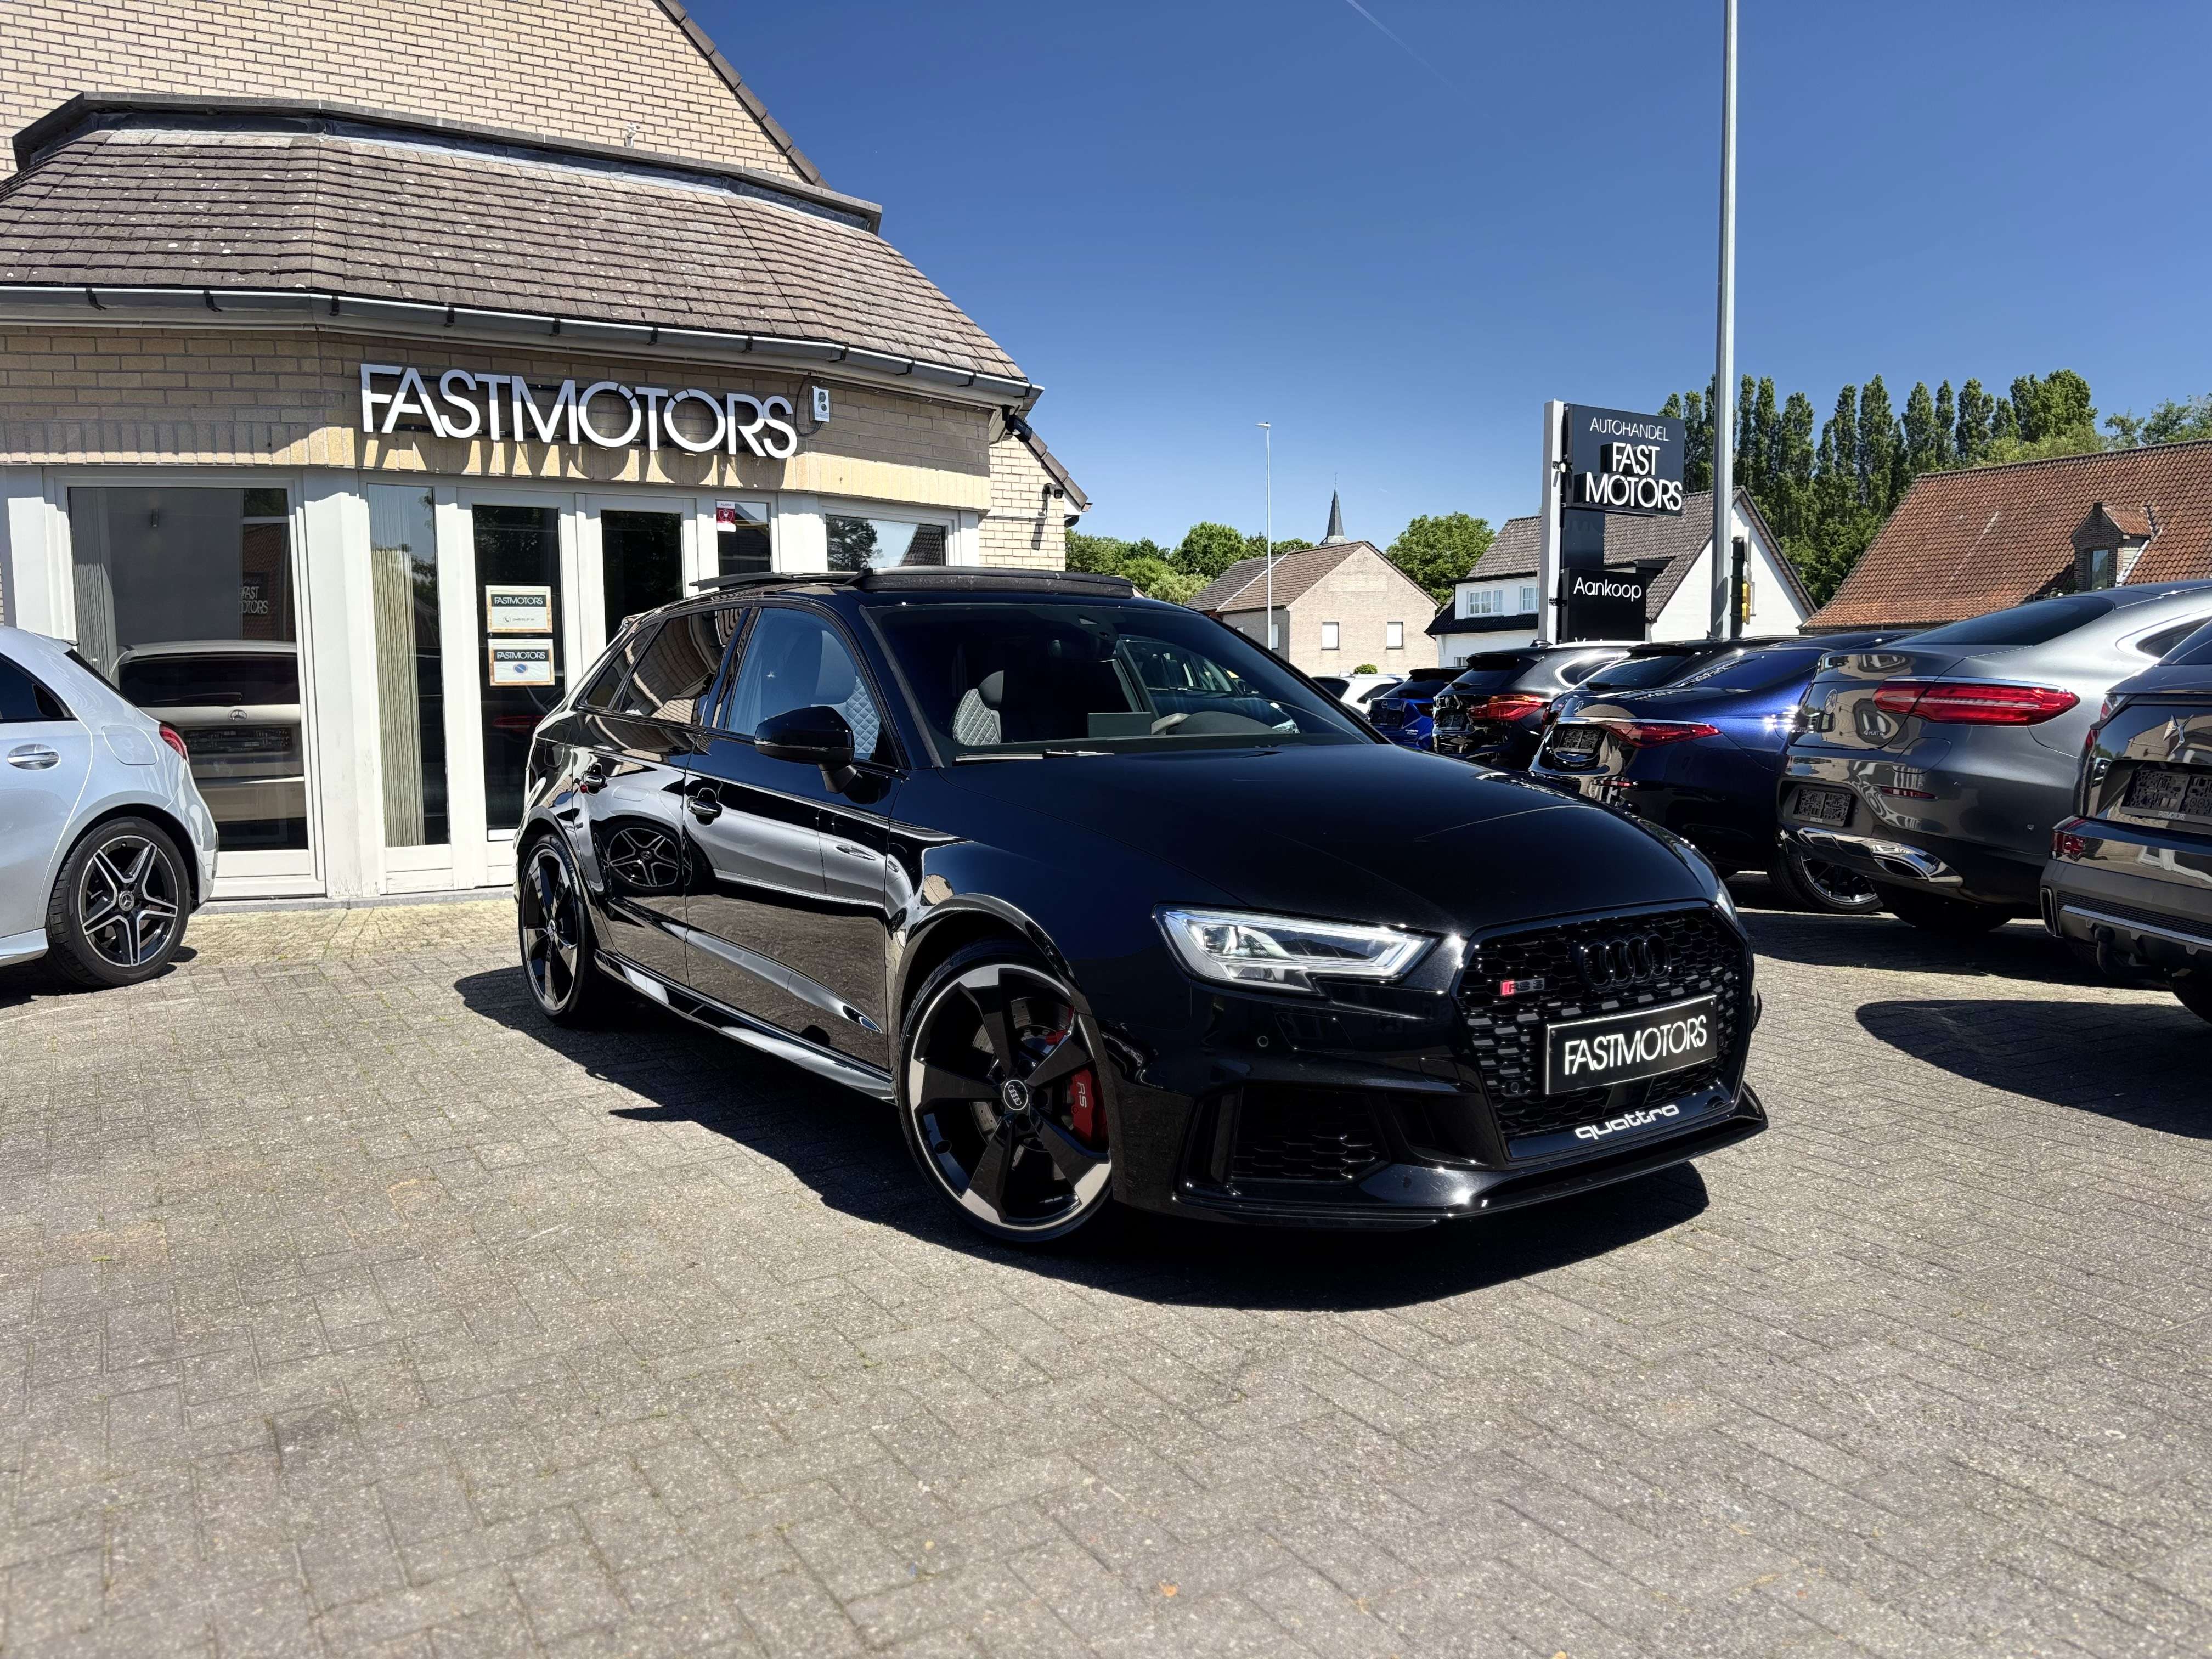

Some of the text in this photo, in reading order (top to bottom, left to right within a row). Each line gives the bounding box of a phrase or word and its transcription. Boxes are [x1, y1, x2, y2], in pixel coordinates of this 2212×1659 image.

[360, 364, 798, 459] FASTMOTORS
[1590, 417, 1671, 442] AUTOHANDEL
[1612, 442, 1660, 475] FAST
[1585, 472, 1683, 511] MOTORS
[494, 597, 543, 605] FASTMOTORS
[1573, 577, 1642, 602] Aankoop
[240, 600, 268, 614] OTORS
[497, 651, 545, 659] FASTMOTORS
[1565, 1015, 1707, 1075] FASTMOTORS
[1077, 1082, 1087, 1108] RS
[1575, 1104, 1679, 1140] quattro
